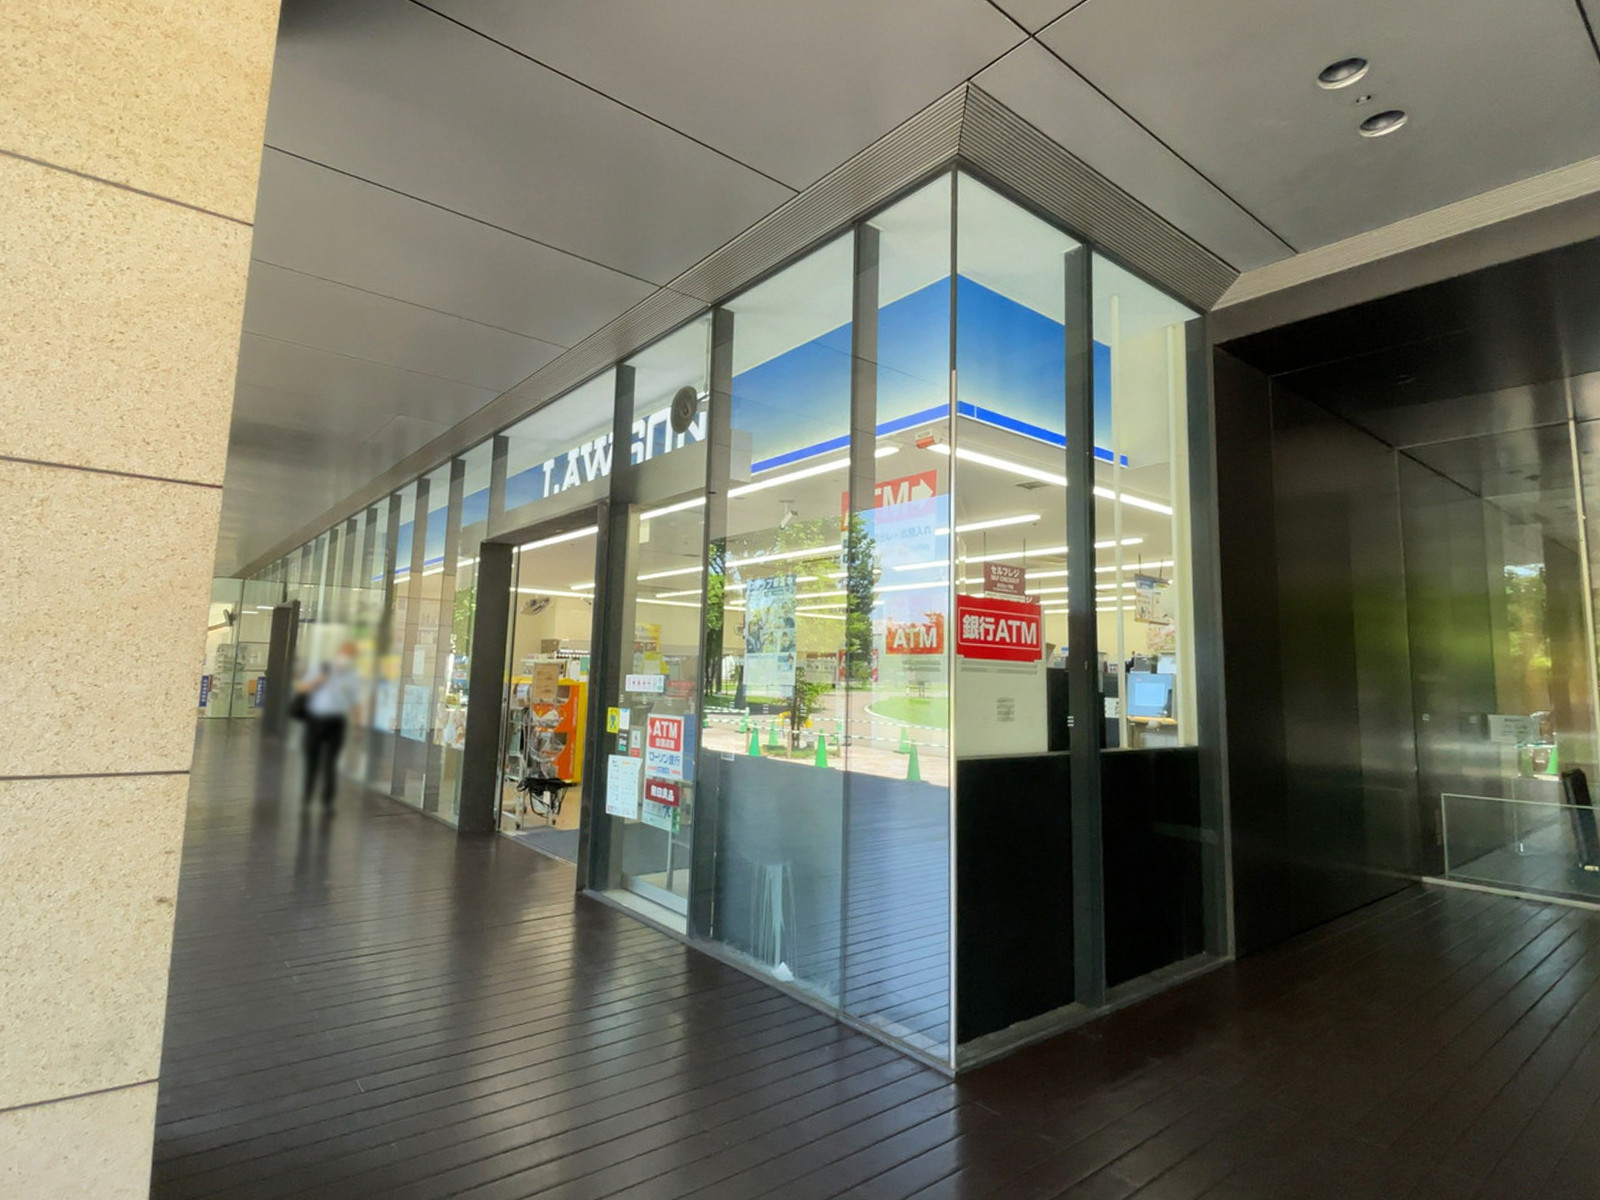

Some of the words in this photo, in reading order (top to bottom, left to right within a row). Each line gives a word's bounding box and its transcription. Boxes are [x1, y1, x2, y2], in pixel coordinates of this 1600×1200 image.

[990, 565, 1020, 578] セルフレジ
[893, 628, 938, 648] ATM
[962, 614, 1037, 645] 銀行ATM
[652, 719, 678, 739] ATM
